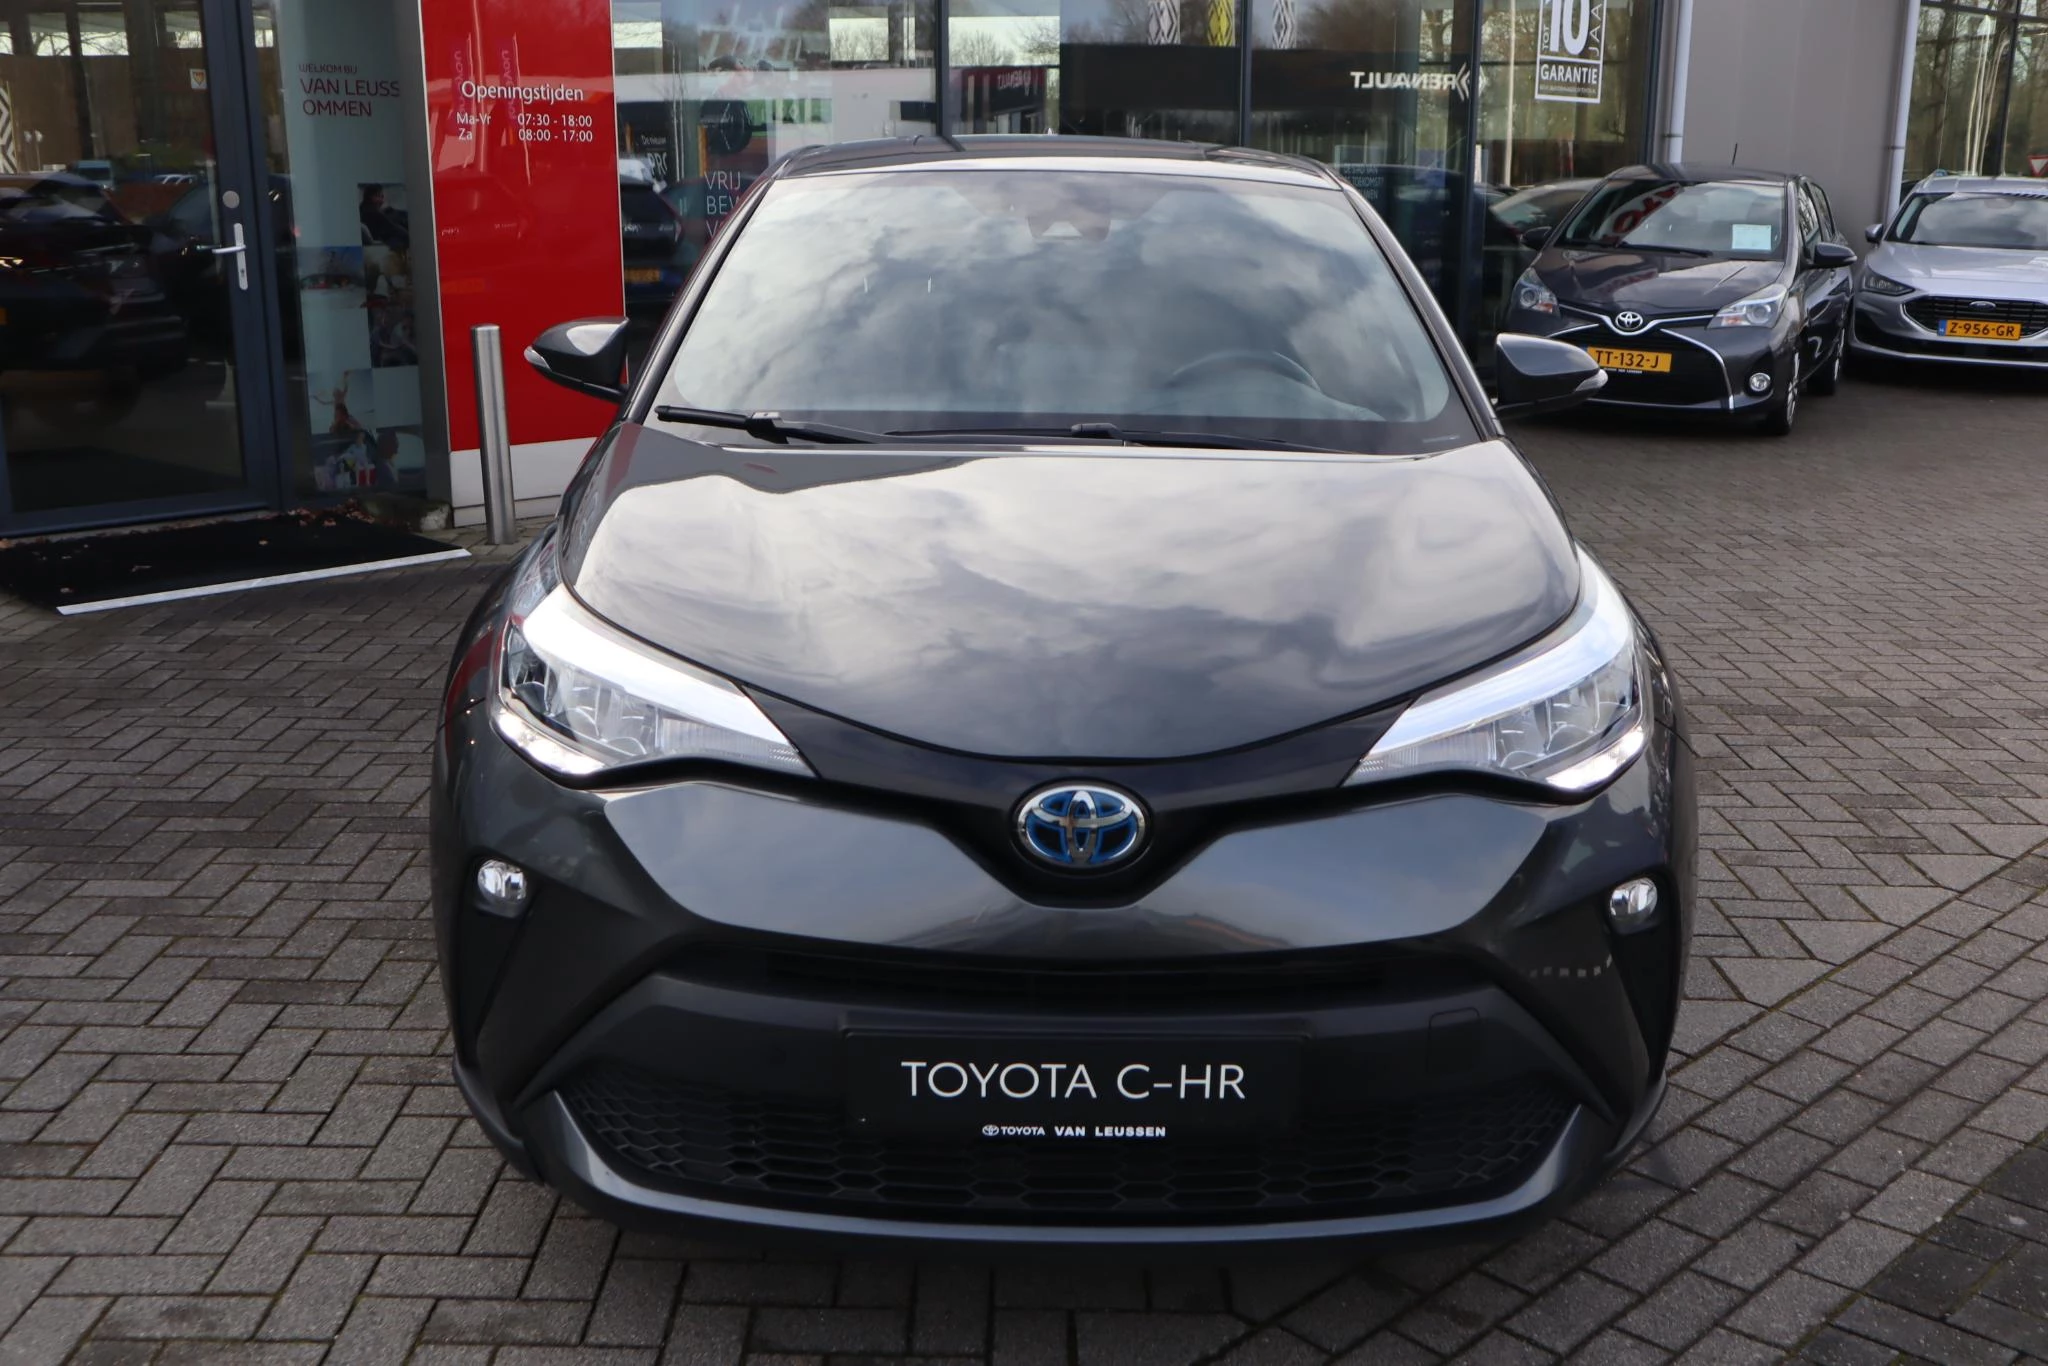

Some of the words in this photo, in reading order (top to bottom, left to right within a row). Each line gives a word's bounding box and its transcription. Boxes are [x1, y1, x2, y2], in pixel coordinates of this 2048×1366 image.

[1545, 0, 1590, 55] 10
[1541, 24, 1550, 50] TOT
[298, 63, 342, 74] WELKOM
[1540, 63, 1598, 85] GARANTIE
[300, 78, 340, 95] VAN
[461, 80, 584, 105] Openingstijden
[302, 99, 372, 117] OMMEN
[456, 111, 492, 125] Ma-Vr
[517, 113, 550, 127] 07:30
[561, 114, 593, 128] 18:00
[458, 127, 473, 141] Za
[518, 128, 551, 141] 08:00
[562, 129, 593, 142] 17:00
[704, 171, 741, 191] VRIJ
[1949, 322, 2015, 337] Z-956-GR
[1595, 350, 1660, 369] TT-132-J
[900, 1061, 1098, 1099] TOYOTA
[1116, 1063, 1246, 1100] C-HR
[1001, 1126, 1046, 1136] TOYOTA
[1054, 1126, 1086, 1137] VAN
[1095, 1126, 1166, 1137] LEUSSEN
